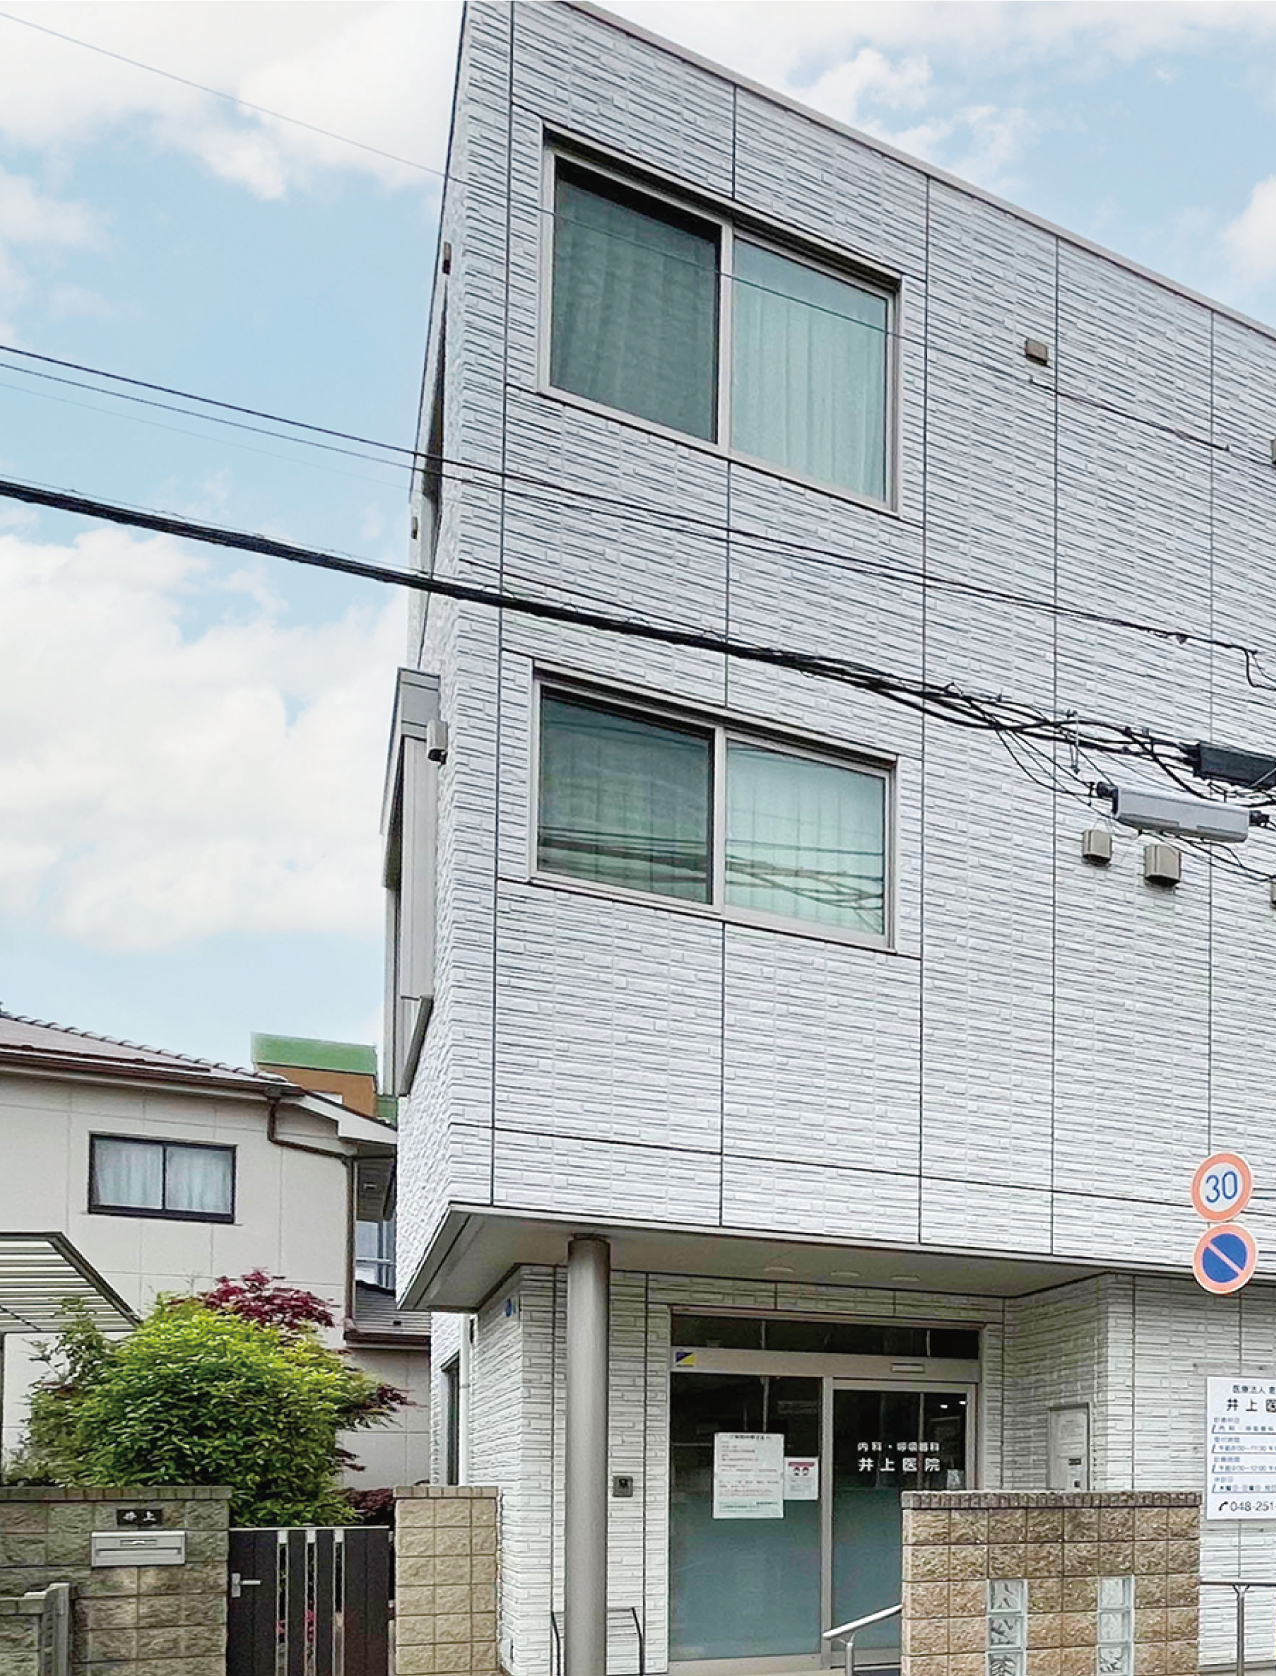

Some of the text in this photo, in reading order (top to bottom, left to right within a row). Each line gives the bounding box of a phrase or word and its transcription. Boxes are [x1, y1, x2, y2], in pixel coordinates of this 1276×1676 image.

[1205, 1171, 1238, 1203] 30
[858, 1457, 940, 1472] 井上医院
